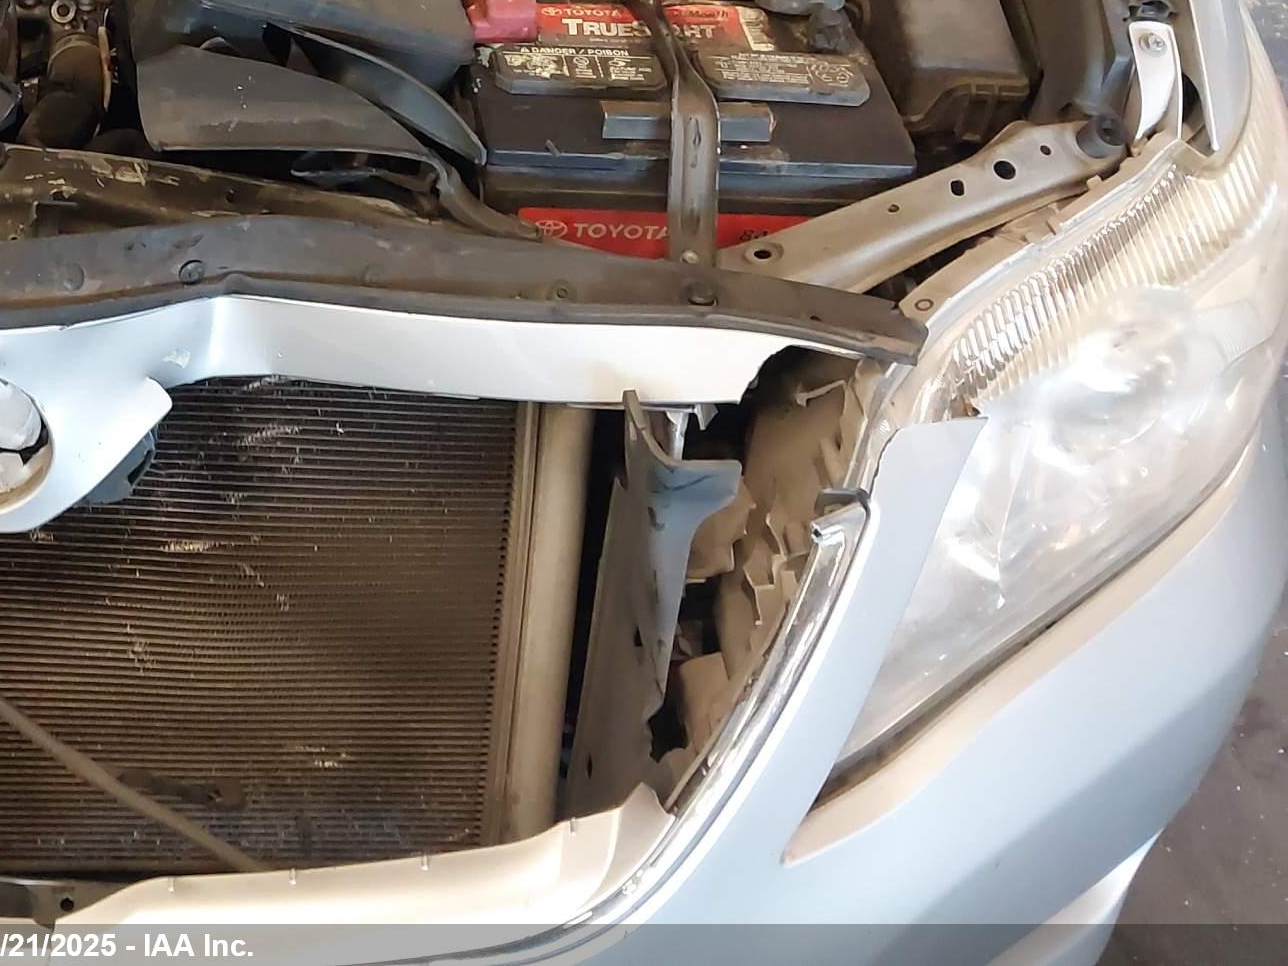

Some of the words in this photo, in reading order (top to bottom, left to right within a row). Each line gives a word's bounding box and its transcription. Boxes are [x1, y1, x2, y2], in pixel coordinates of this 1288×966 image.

[564, 8, 622, 18] TOYOTA
[531, 47, 576, 55] DANGER
[587, 48, 630, 57] POISON
